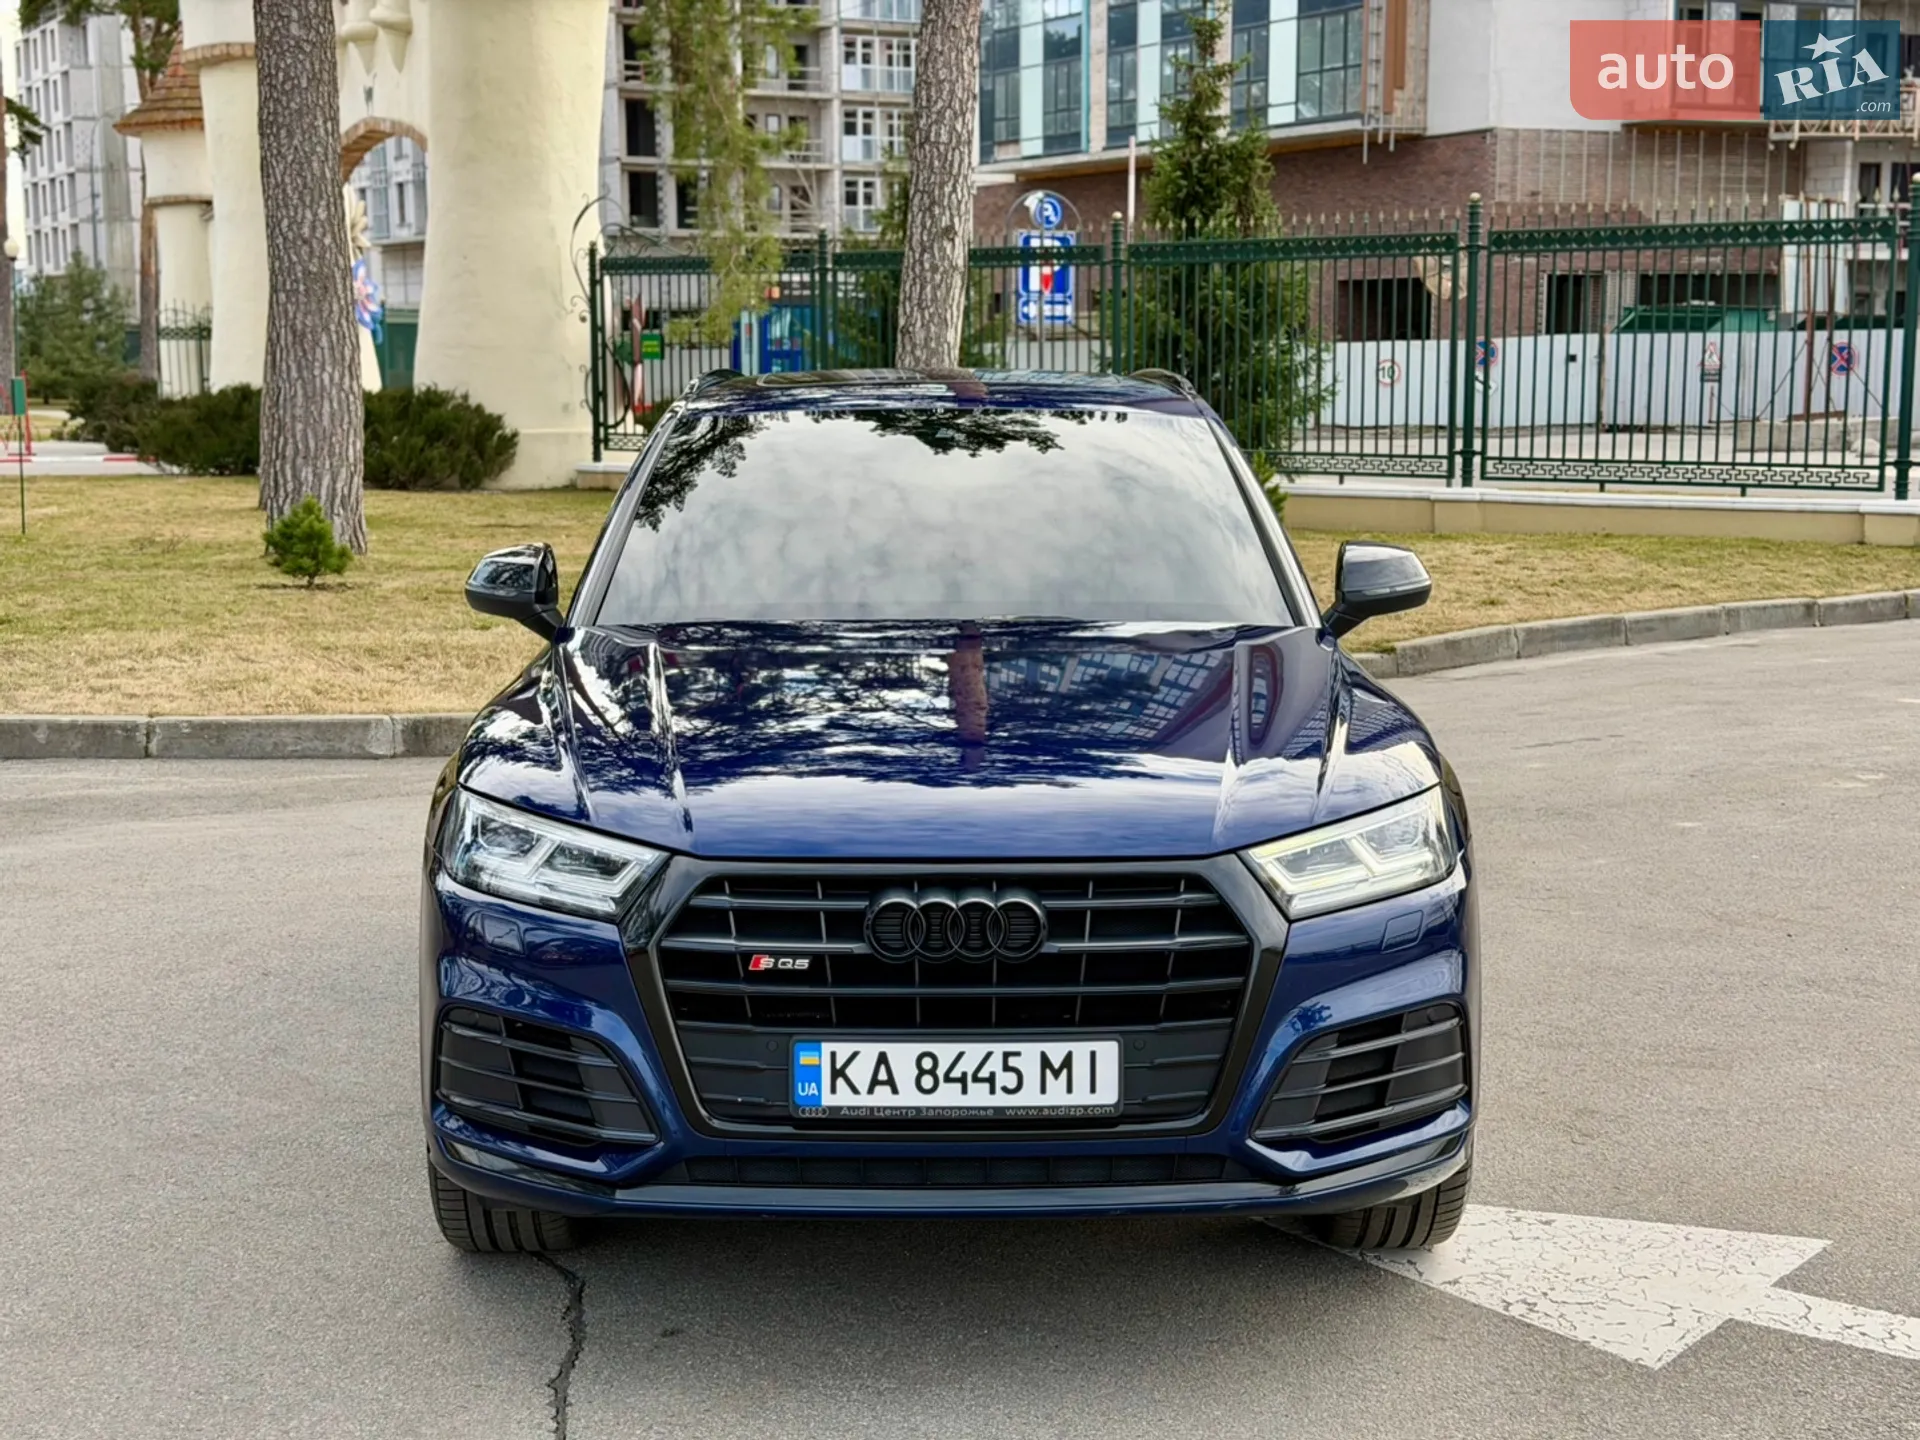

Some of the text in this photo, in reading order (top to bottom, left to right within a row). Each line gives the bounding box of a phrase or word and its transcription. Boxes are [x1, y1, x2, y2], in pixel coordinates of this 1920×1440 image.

[1379, 365, 1395, 380] 10
[830, 1049, 1097, 1096] KA 8445 MI
[798, 1082, 819, 1097] UA
[839, 1105, 1115, 1118] Audi Центр Запорожье www.audizp.com
